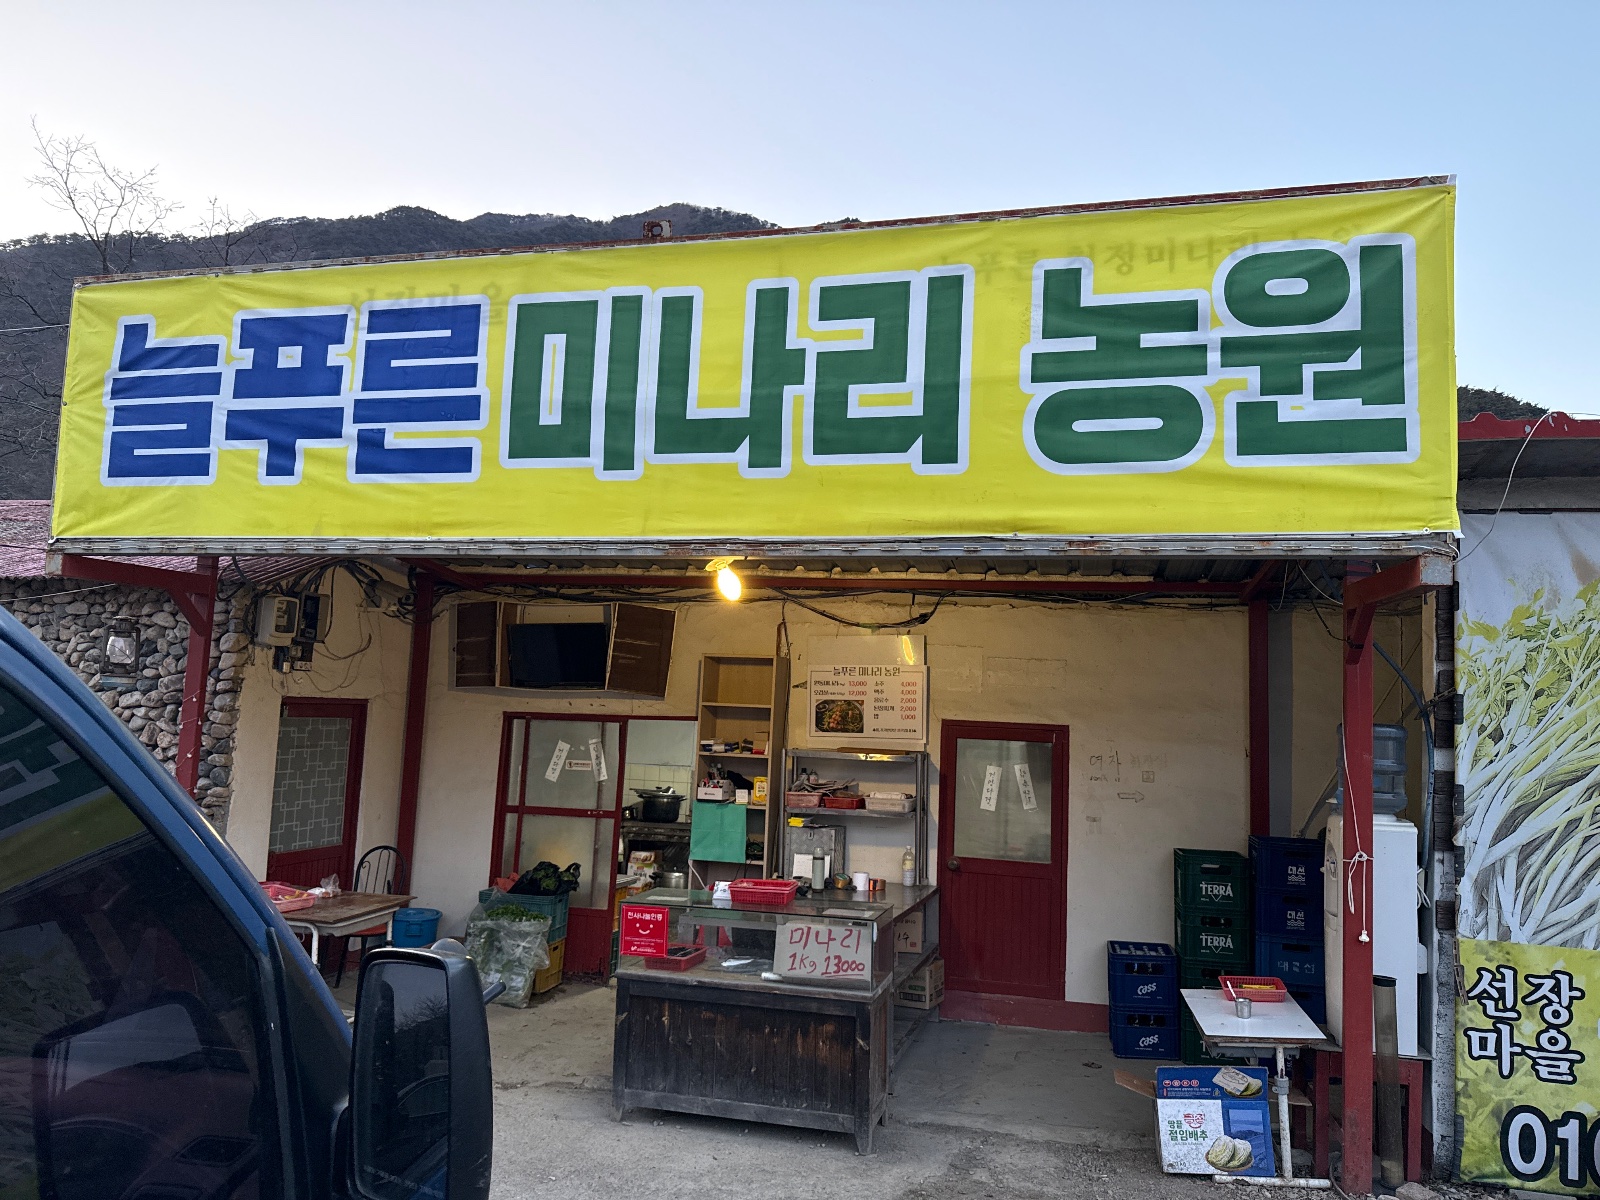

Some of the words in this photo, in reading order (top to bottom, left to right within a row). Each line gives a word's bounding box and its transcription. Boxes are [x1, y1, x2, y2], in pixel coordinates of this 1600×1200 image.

[1021, 232, 1421, 476] 농원
[833, 666, 857, 676] 늘푸른
[859, 666, 882, 676] 미나리
[884, 666, 900, 676] 농원
[1089, 750, 1122, 776] 여자
[1199, 881, 1233, 898] TERRA
[788, 925, 862, 955] 미나리
[1199, 933, 1234, 949] TERRA
[823, 954, 866, 977] 13000
[1467, 964, 1585, 1028] 선장
[1463, 1021, 1585, 1085] 마을
[1168, 1129, 1208, 1141] 절임배추
[1500, 1105, 1600, 1189] 01
